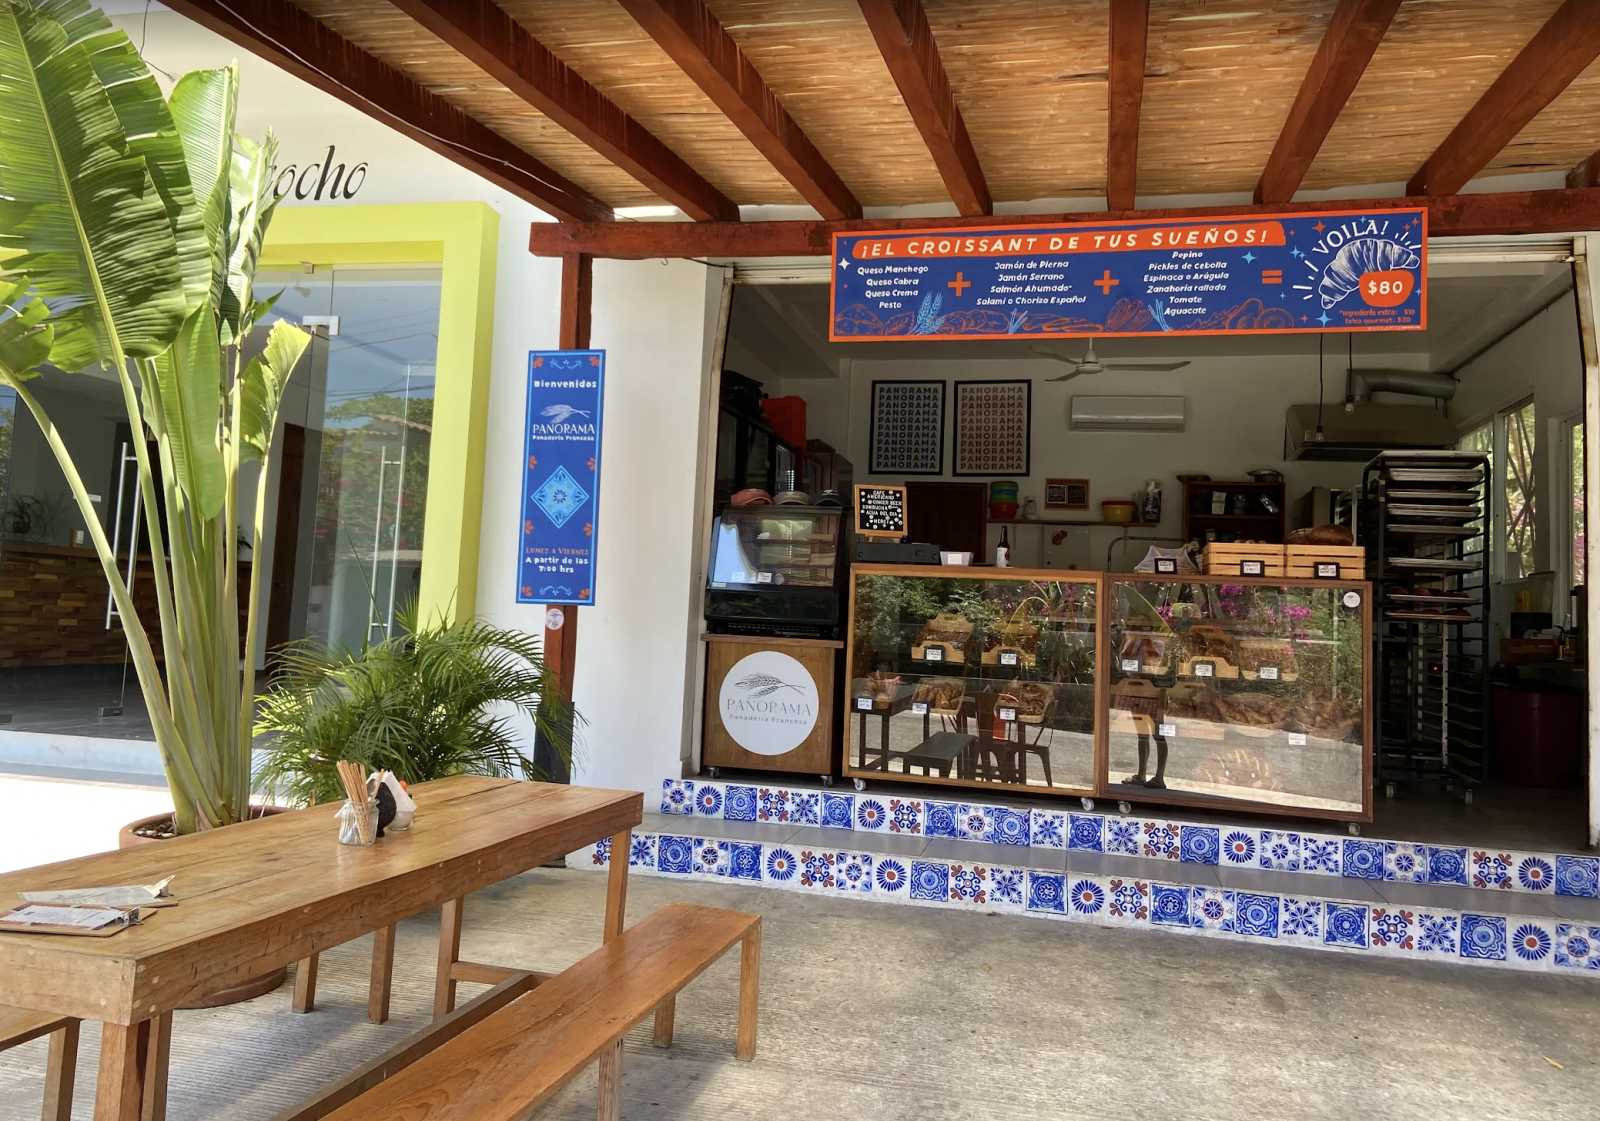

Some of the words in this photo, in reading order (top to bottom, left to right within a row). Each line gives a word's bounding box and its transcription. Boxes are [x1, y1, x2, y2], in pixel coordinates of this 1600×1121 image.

[1311, 219, 1390, 255] VOILA!
[862, 243, 895, 258] ¡EL
[907, 237, 1037, 255] CROISSANT
[1049, 236, 1080, 251] DE
[1093, 234, 1138, 249] TUS
[1151, 228, 1268, 246] SUEÑOS!
[1171, 250, 1203, 260] Pepino
[994, 260, 1025, 270] Jamón
[1026, 260, 1038, 269] de
[1039, 260, 1070, 269] Pierna
[1148, 263, 1179, 272] Pickles
[1181, 261, 1192, 270] de
[857, 267, 884, 276] Queso
[884, 265, 929, 275] Manchego
[866, 278, 893, 287] Queso
[893, 277, 920, 286] Cabra
[998, 272, 1028, 282] Jamón
[1029, 273, 1065, 281] Serrano
[1143, 275, 1184, 283] Espinaca
[1192, 272, 1230, 282] Arúgula
[990, 284, 1023, 294] Salmón
[1146, 286, 1193, 294] Zanahoria
[1193, 283, 1227, 292] rallada
[1368, 280, 1403, 296] $80
[865, 290, 891, 298] Queso
[892, 289, 919, 297] Crema
[879, 301, 902, 309] Pesto
[976, 297, 1007, 306] Salami
[1015, 297, 1049, 305] Chorizo
[1050, 295, 1087, 306] Español
[1169, 296, 1203, 304] Tomate
[1163, 307, 1207, 316] Aguacate
[533, 379, 597, 389] Bienvenidos
[533, 423, 595, 435] PANORAMA
[961, 432, 1023, 440] PANORAMA
[961, 447, 1022, 455] PANORAMA
[534, 556, 560, 565] partir
[562, 557, 573, 565] de
[575, 557, 589, 565] las
[559, 565, 575, 573] hrs
[726, 698, 811, 716] PANORAMA
[772, 716, 807, 725] Francesa
